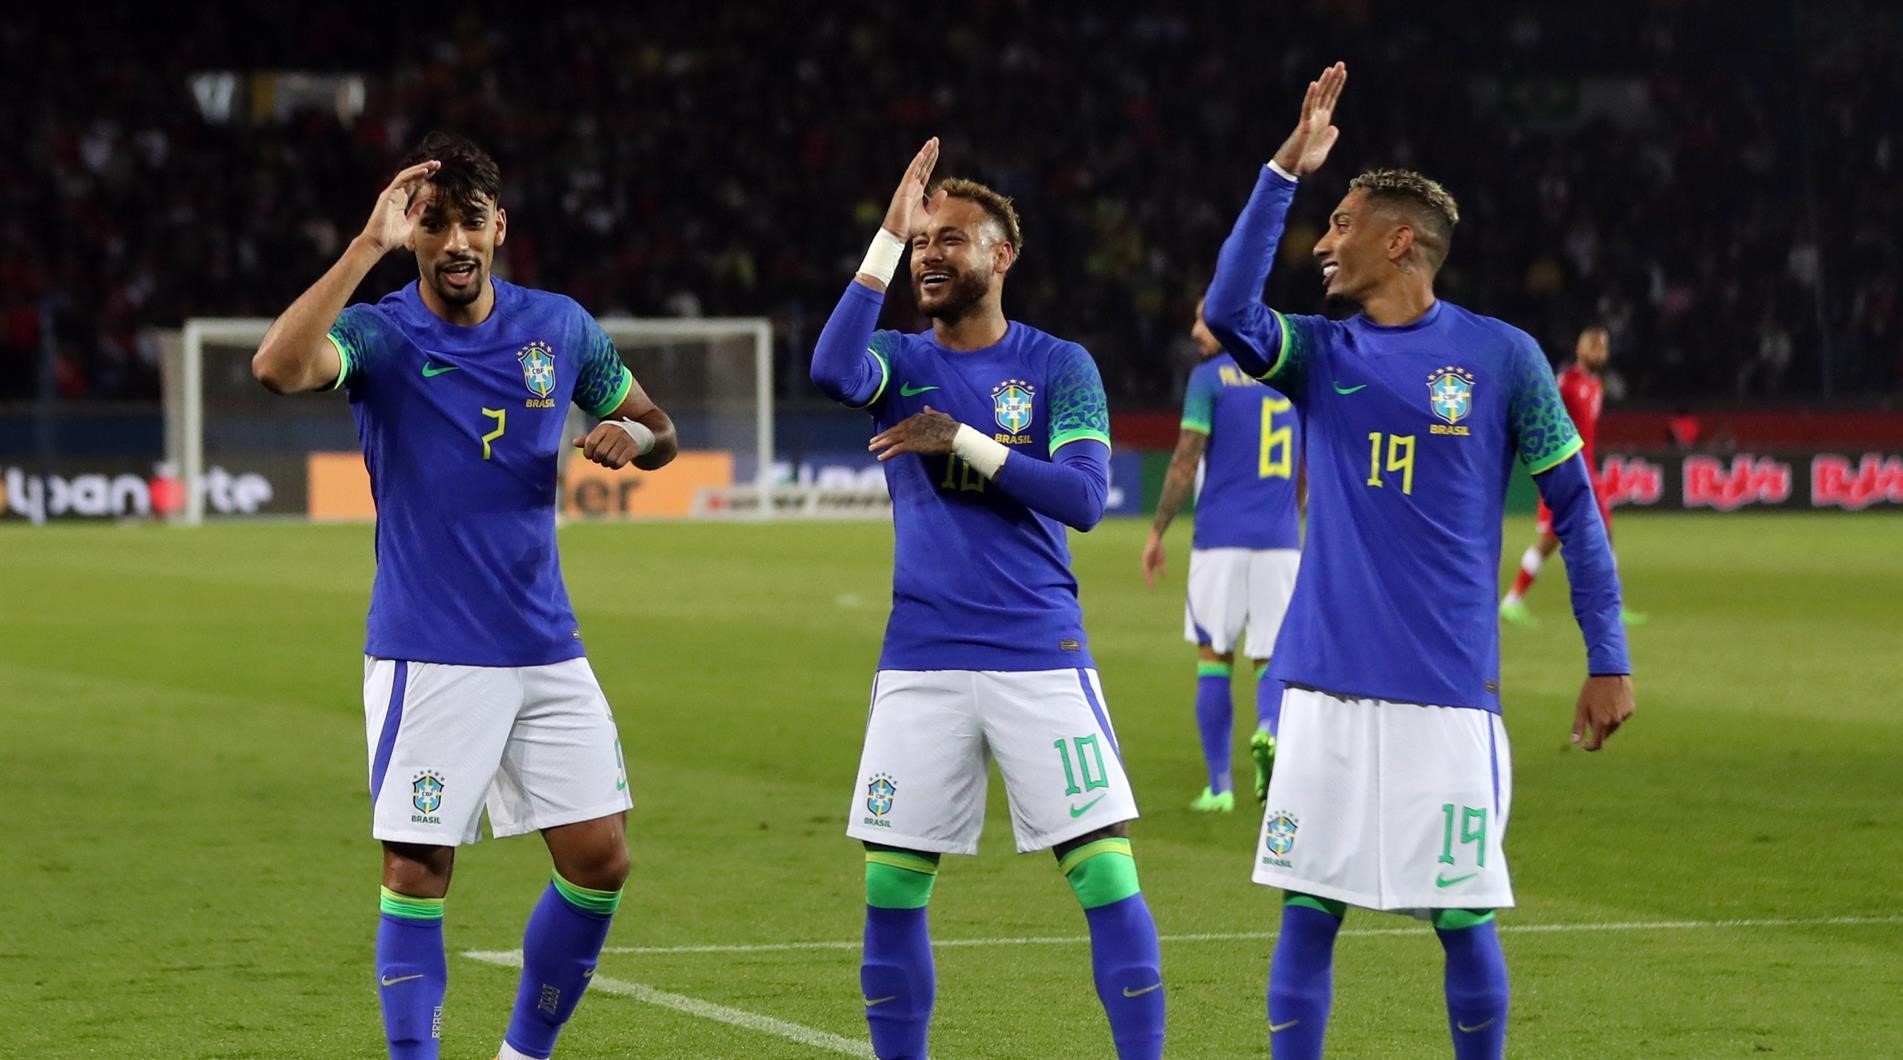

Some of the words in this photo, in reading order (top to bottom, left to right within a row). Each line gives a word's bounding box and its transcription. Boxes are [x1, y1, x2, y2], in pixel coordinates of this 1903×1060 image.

[525, 398, 555, 408] BRASIL
[481, 407, 506, 460] 7
[994, 433, 1033, 444] BRASIL
[1259, 396, 1293, 480] 6
[1429, 424, 1471, 435] BRASIL
[1367, 431, 1416, 496] 19
[1054, 733, 1109, 797] 10
[411, 815, 442, 824] BRASIL
[863, 817, 892, 828] BRASIL
[1438, 803, 1487, 868] 19
